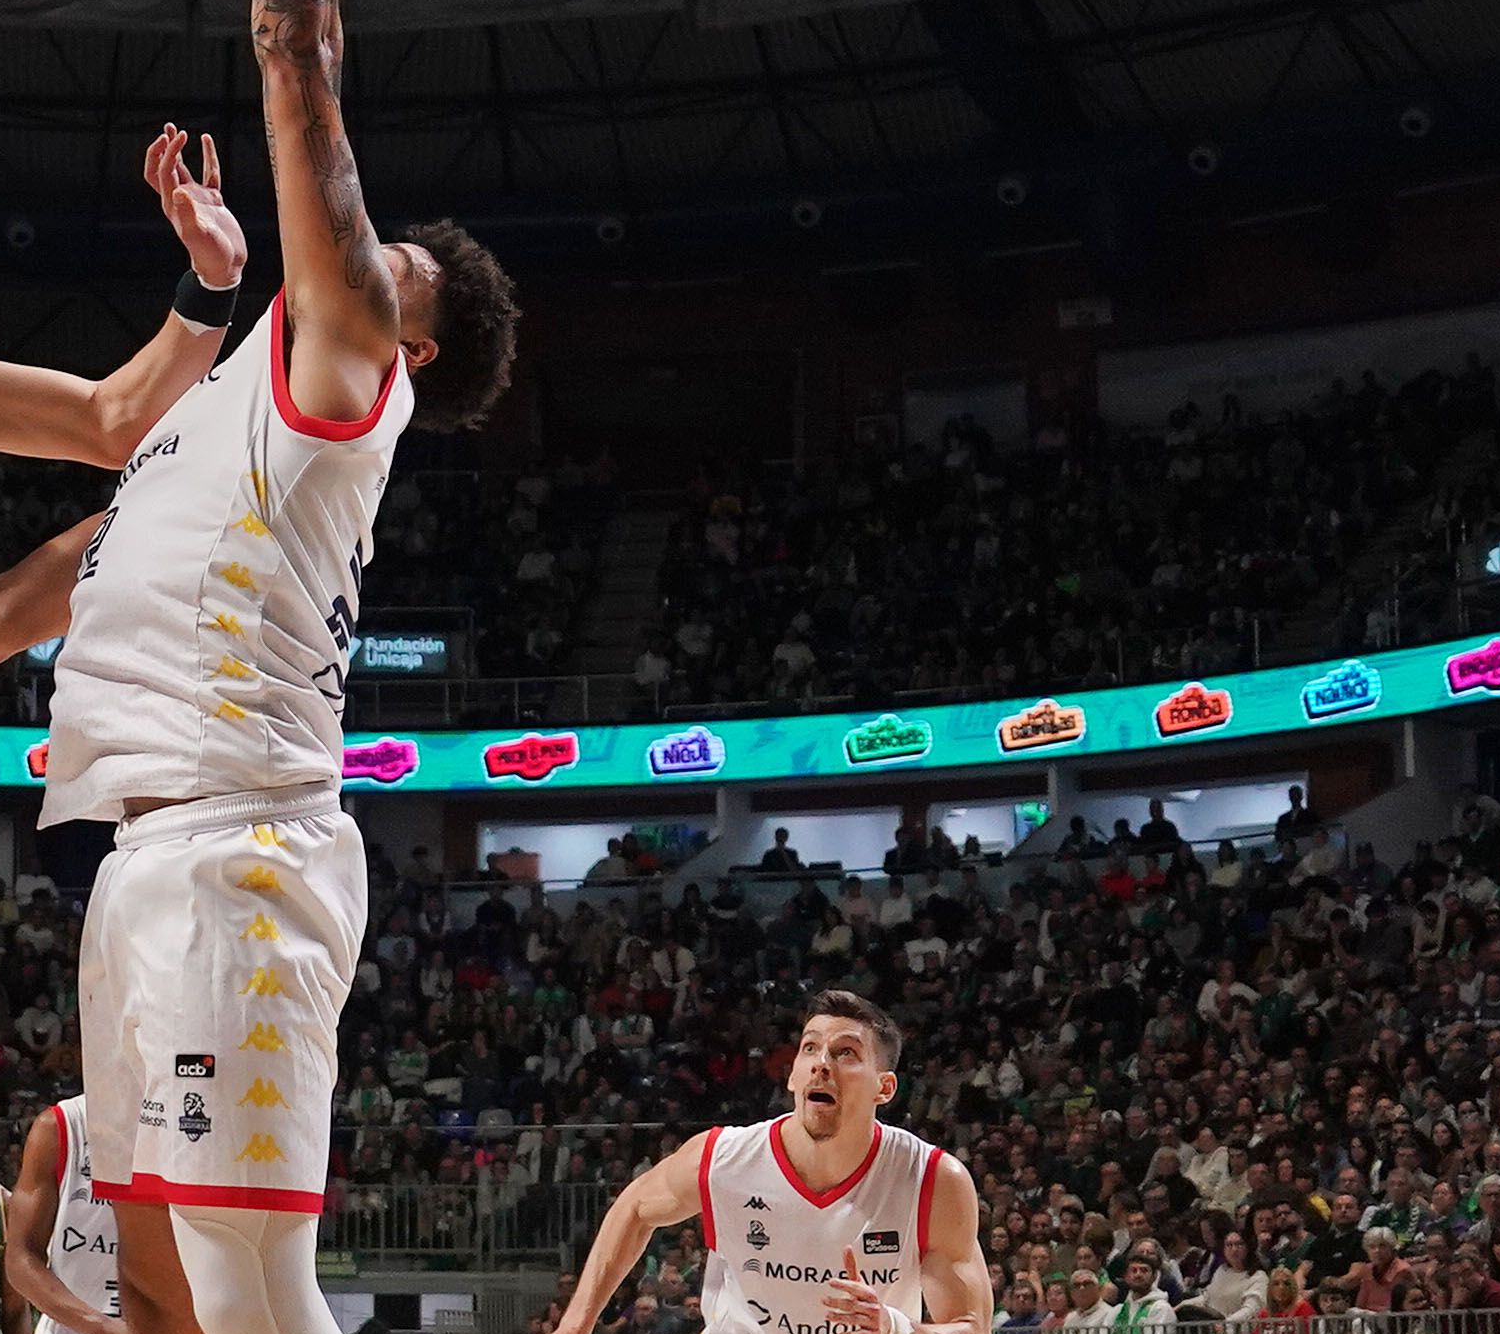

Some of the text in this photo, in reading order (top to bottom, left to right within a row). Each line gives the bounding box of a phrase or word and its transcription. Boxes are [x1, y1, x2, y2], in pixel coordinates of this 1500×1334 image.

[365, 636, 446, 655] Fundación
[365, 651, 424, 670] Unicaja
[177, 1063, 206, 1076] acb
